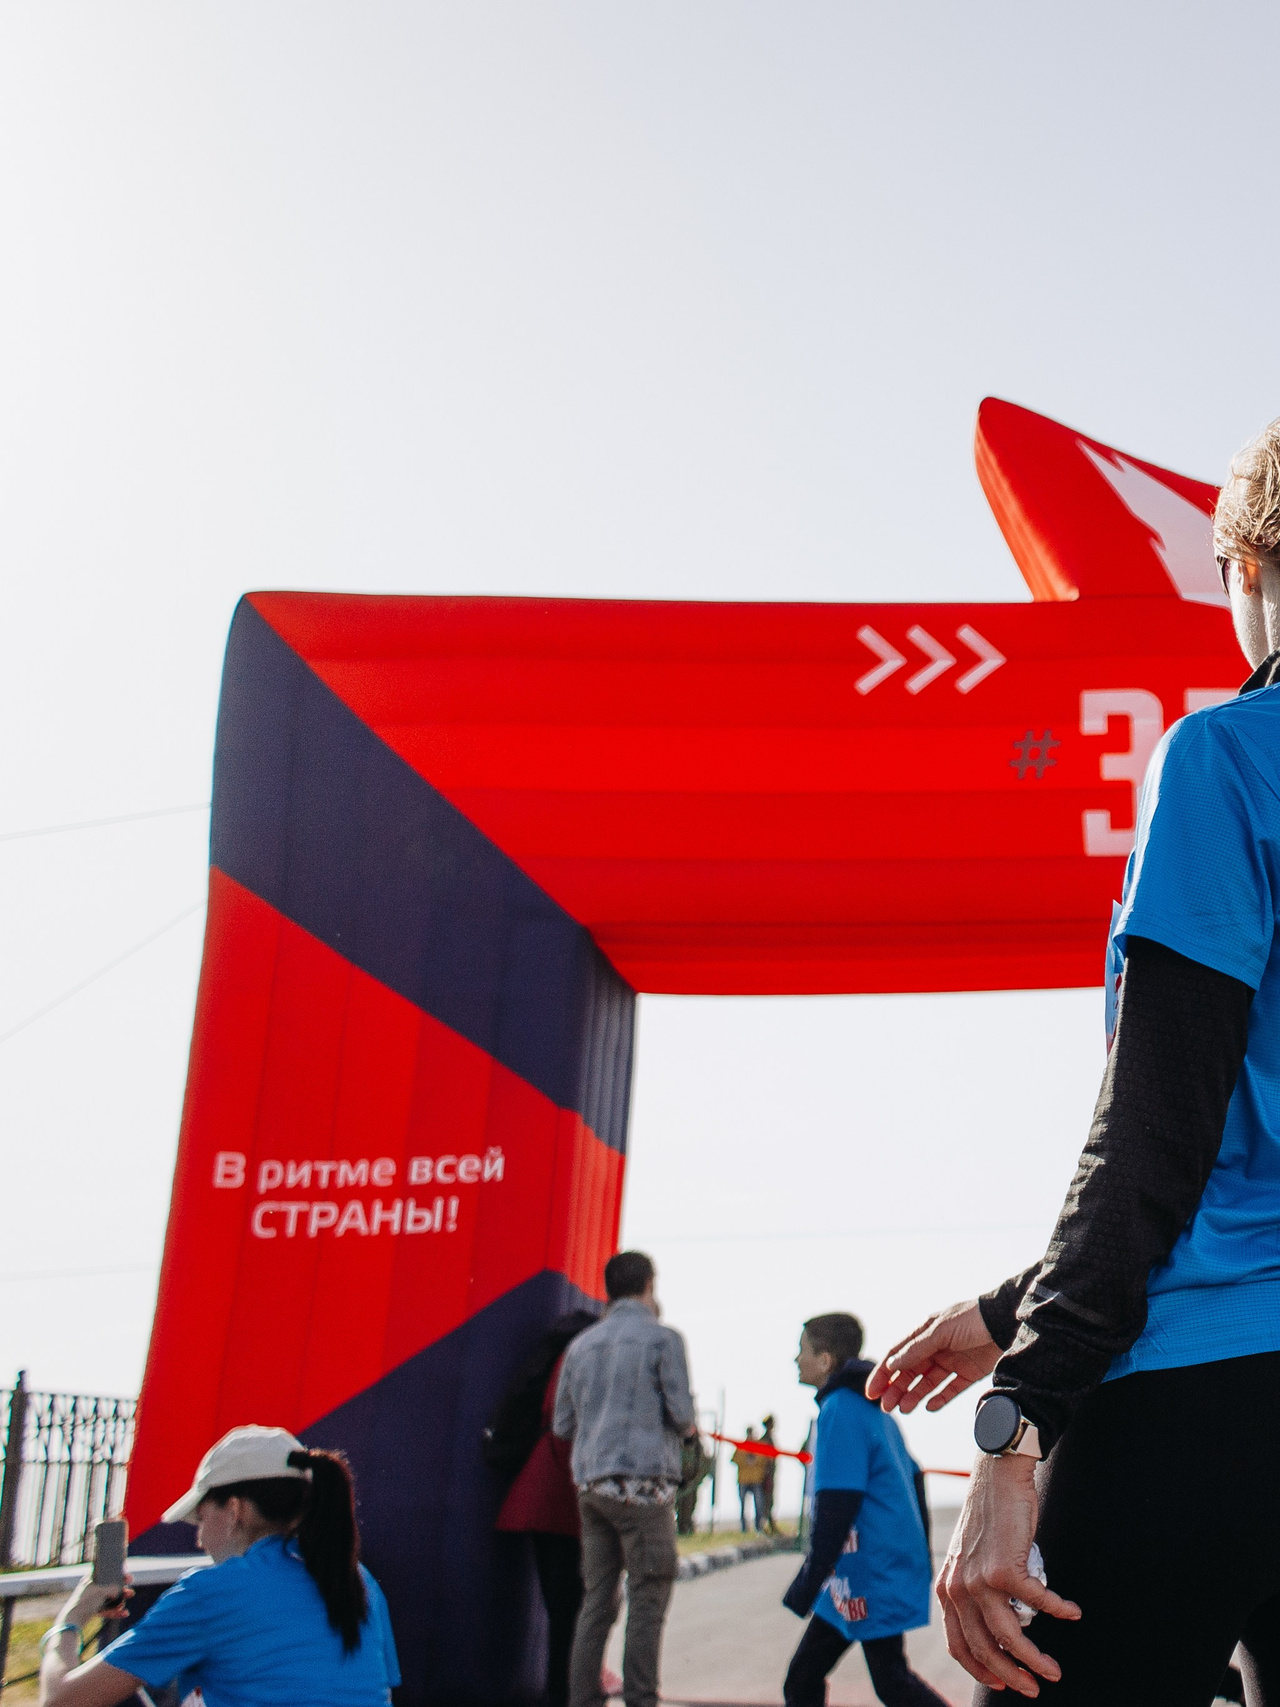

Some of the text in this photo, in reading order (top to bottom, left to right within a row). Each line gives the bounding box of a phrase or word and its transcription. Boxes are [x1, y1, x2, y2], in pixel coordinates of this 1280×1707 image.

[213, 1146, 505, 1194] В ритме всей
[252, 1195, 459, 1239] СТРАНЫ!
